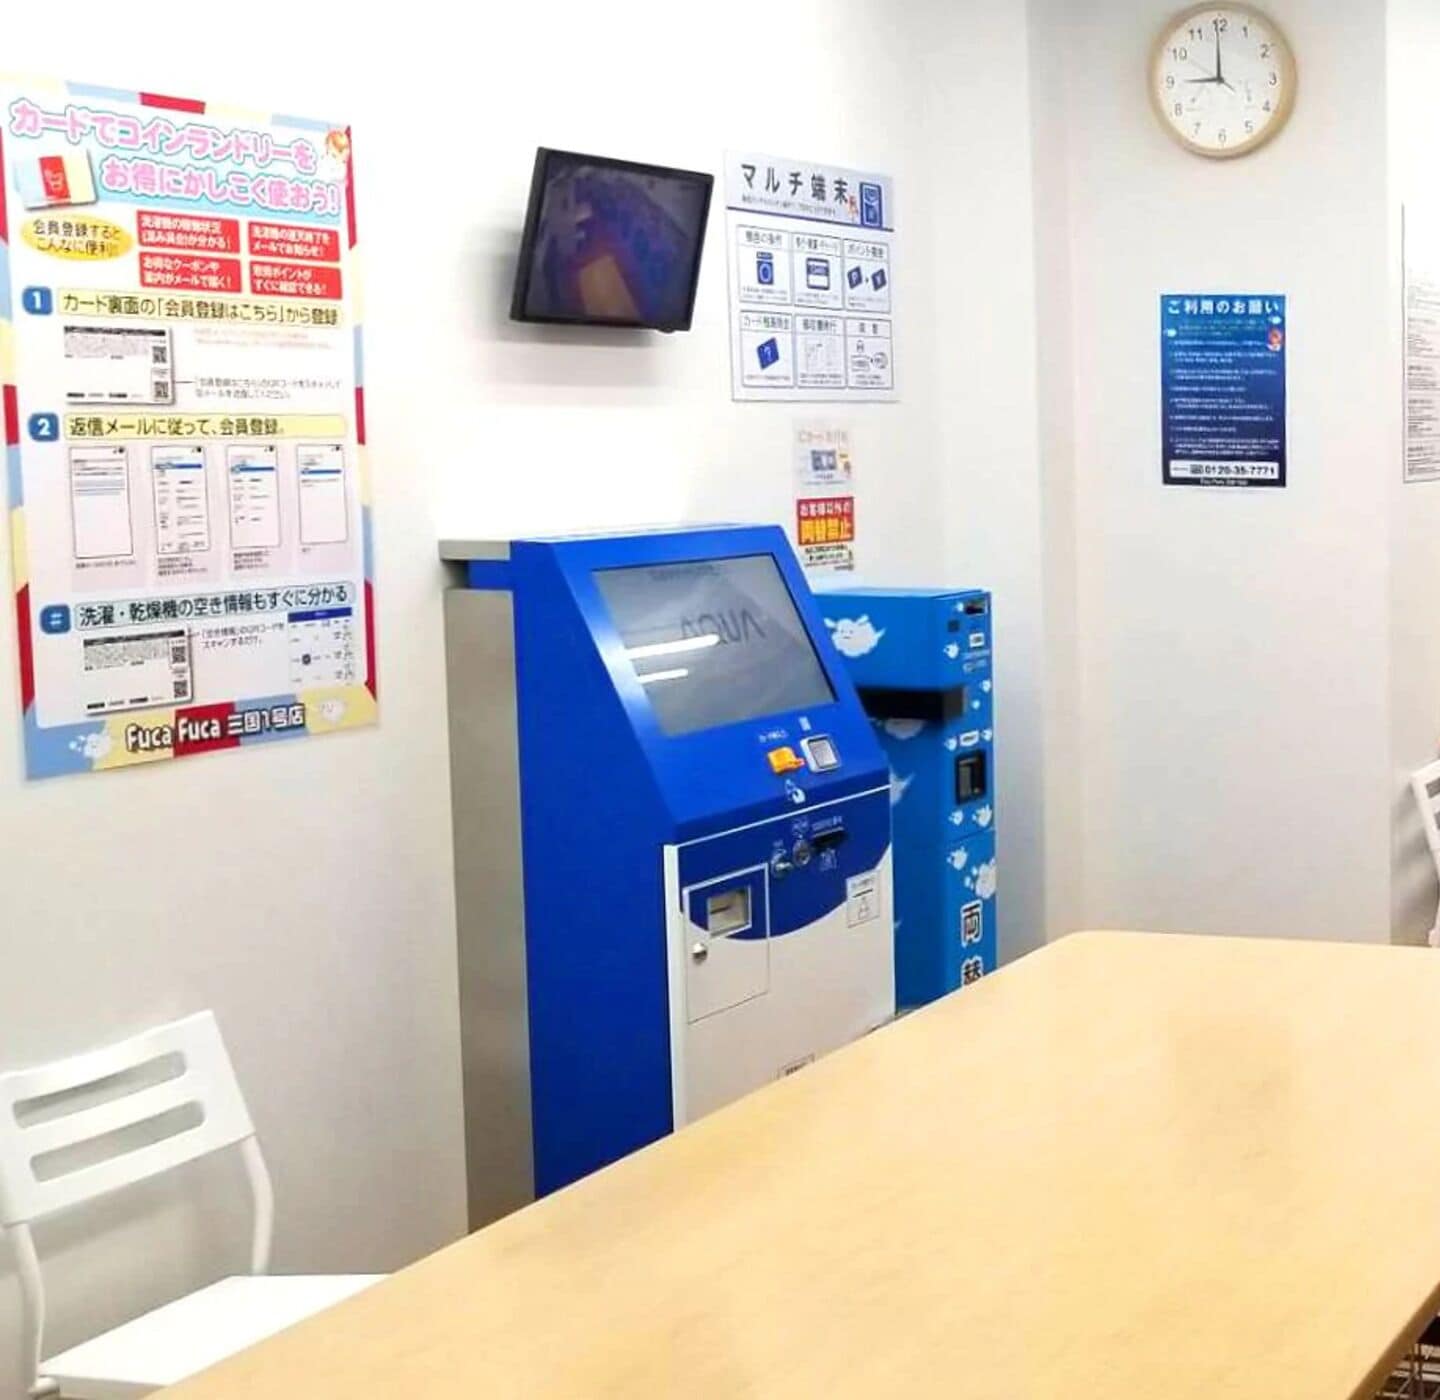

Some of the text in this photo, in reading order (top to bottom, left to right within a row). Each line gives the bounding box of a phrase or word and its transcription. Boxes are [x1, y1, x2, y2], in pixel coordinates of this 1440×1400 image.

[1212, 18, 1228, 32] 12
[1242, 25, 1249, 38] 1
[1188, 28, 1203, 41] 11
[1172, 47, 1188, 61] 10
[1260, 44, 1270, 59] 2
[1166, 75, 1175, 89] 9
[1268, 73, 1277, 86] 3
[1174, 103, 1183, 117] 8
[1262, 100, 1271, 112] 4
[1194, 121, 1202, 134] 7
[1244, 120, 1253, 133] 5
[9, 98, 317, 173] カードでコインランドリーを
[1218, 129, 1227, 143] 6
[741, 163, 849, 205] マルチ端末
[33, 218, 121, 242] 会員登録すると
[63, 294, 338, 324] カード裏面の「会員登録はこちら」から登録
[1167, 299, 1280, 315] ご利用のお願い
[79, 589, 349, 627] 洗濯・乾燥機の空き情報もすぐに分かる
[125, 704, 305, 750] Fuca Fuca 三国1号店
